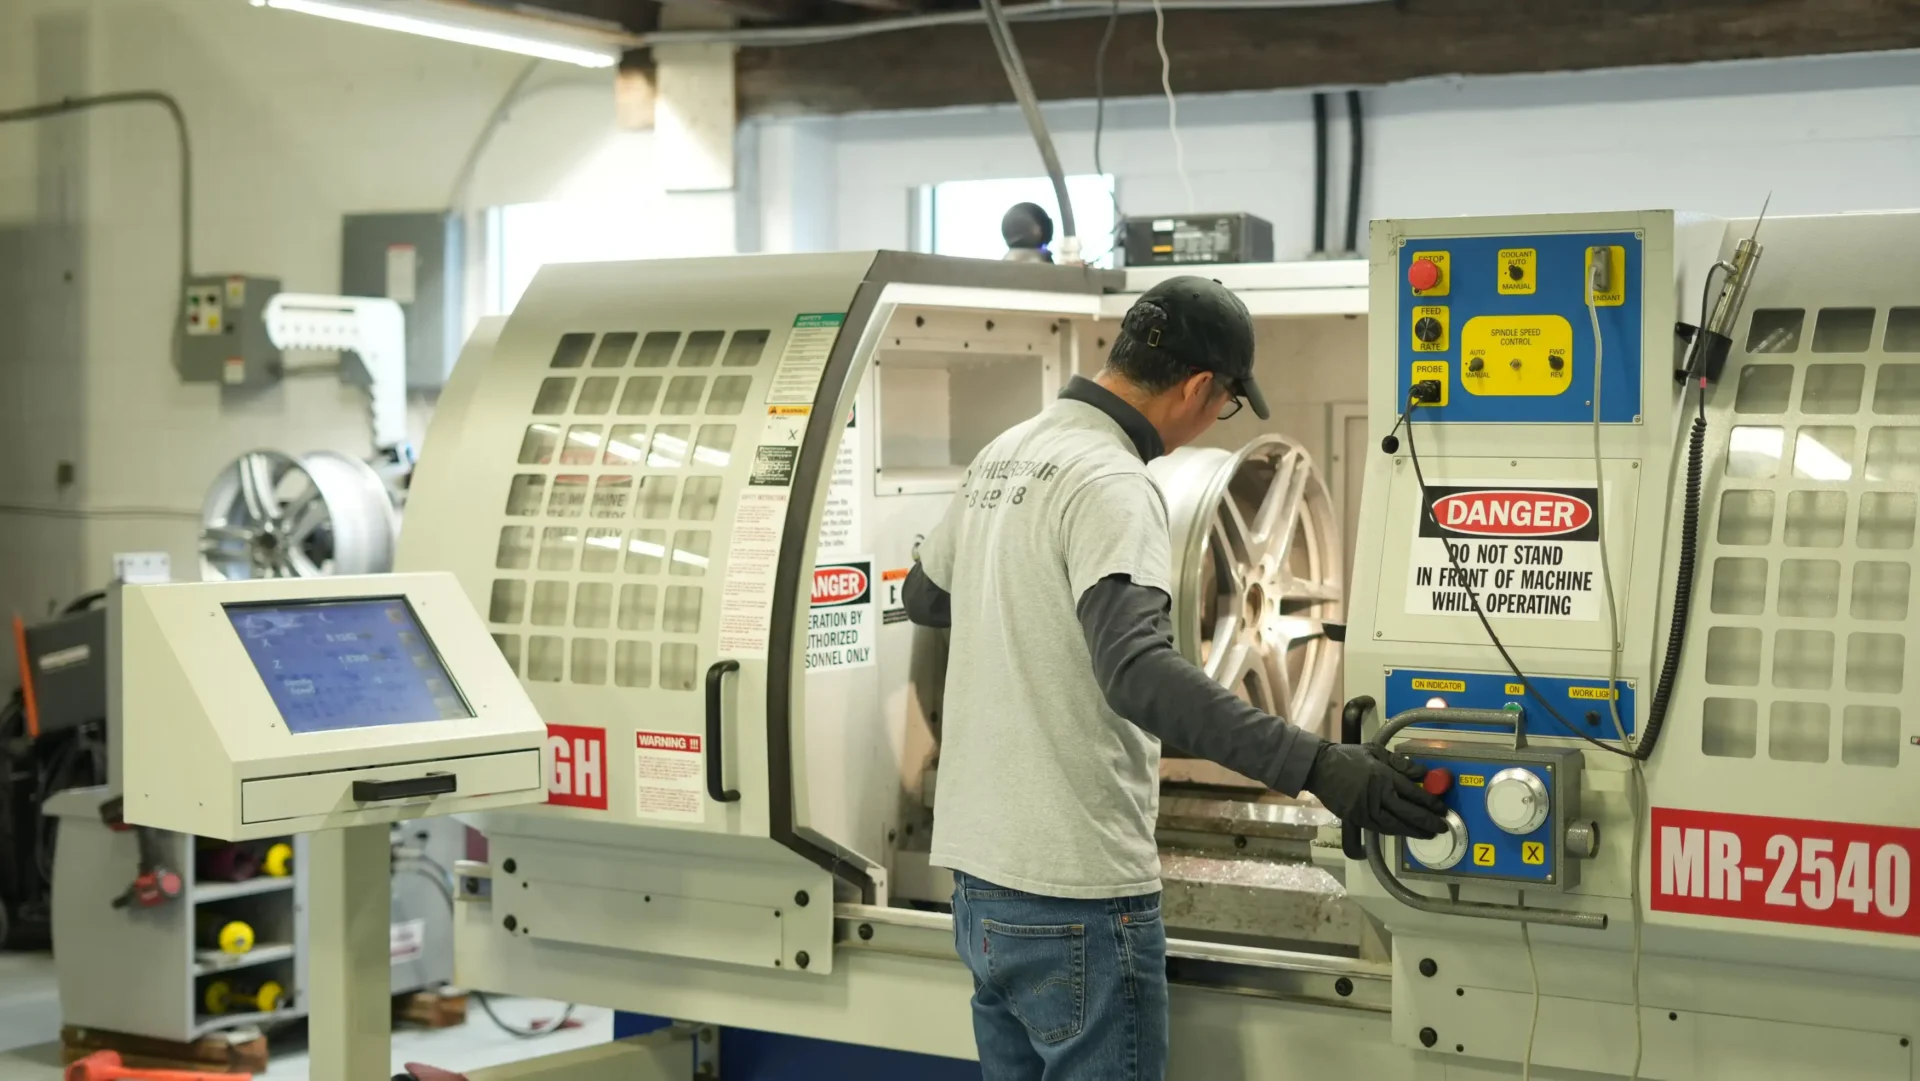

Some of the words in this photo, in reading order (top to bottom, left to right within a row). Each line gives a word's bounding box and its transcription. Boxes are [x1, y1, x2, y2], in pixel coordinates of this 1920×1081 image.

[1507, 258, 1527, 266] AUTO
[1502, 283, 1532, 291] MANUAL
[1421, 307, 1441, 315] FEED
[1490, 329, 1518, 337] SPINDLE
[1519, 328, 1541, 336] SPEED
[1420, 343, 1441, 351] RATE
[1500, 338, 1532, 346] CONTROL
[1416, 365, 1443, 373] PROBE
[1446, 499, 1576, 528] DANGER
[1449, 543, 1469, 564] DO
[1476, 543, 1508, 564] NOT
[1513, 545, 1563, 566] STAND
[811, 573, 860, 598] ANGER
[1416, 566, 1432, 586] IN
[1439, 567, 1488, 588] FRONT
[1494, 568, 1515, 589] OF
[1520, 569, 1593, 591] MACHINE
[1432, 591, 1480, 612] WHILE
[1486, 593, 1572, 616] OPERATING
[808, 611, 847, 630] ERATION
[850, 610, 863, 626] BY
[806, 629, 858, 650] UTHORIZED
[805, 650, 843, 669] SONNEL
[846, 647, 871, 664] ONLY
[1414, 680, 1425, 688] ON
[1426, 681, 1462, 691] INDICATOR
[1509, 685, 1520, 693] ON
[1572, 689, 1594, 698] WORK
[638, 734, 687, 749] WARNING
[1459, 776, 1485, 785] ESTOP
[1478, 847, 1491, 863] Z
[1527, 845, 1540, 862] X
[1660, 825, 1911, 918] MR-2540
